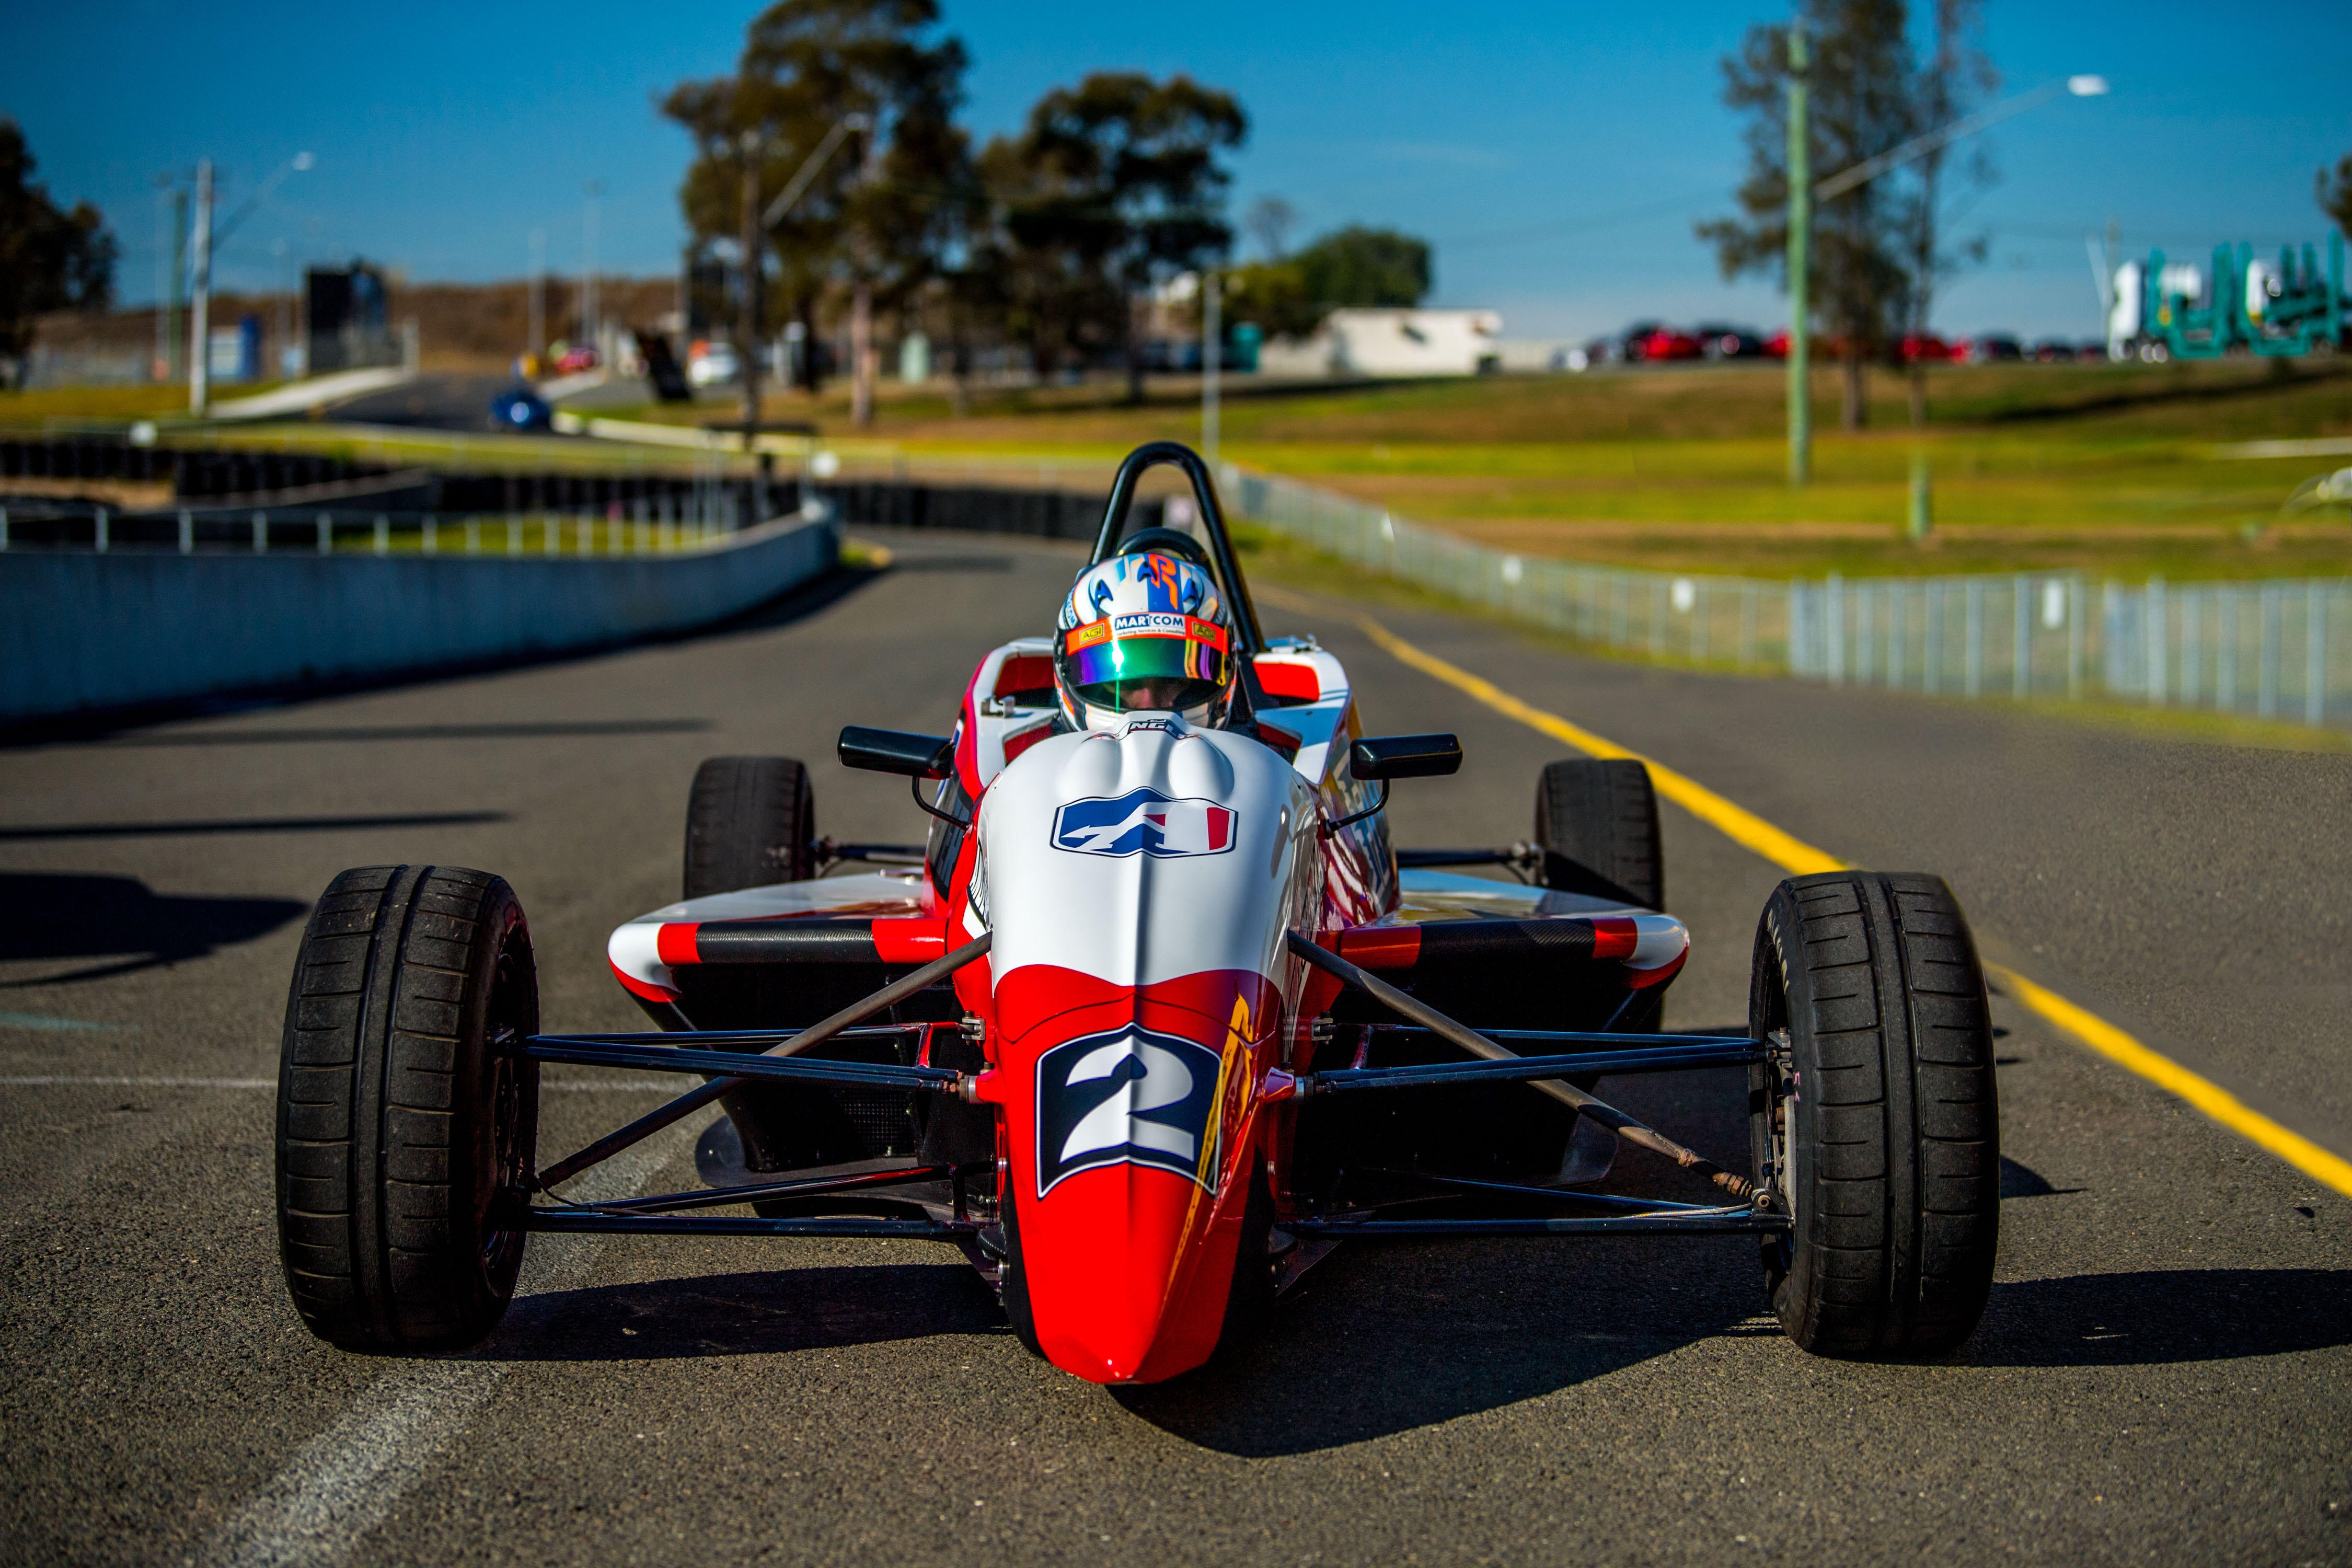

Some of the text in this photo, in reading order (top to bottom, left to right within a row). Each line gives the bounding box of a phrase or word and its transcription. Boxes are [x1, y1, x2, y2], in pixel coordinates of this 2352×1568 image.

[1116, 616, 1183, 629] MARTCOM
[1082, 627, 1101, 640] AGI
[1058, 1035, 1194, 1163] 2
